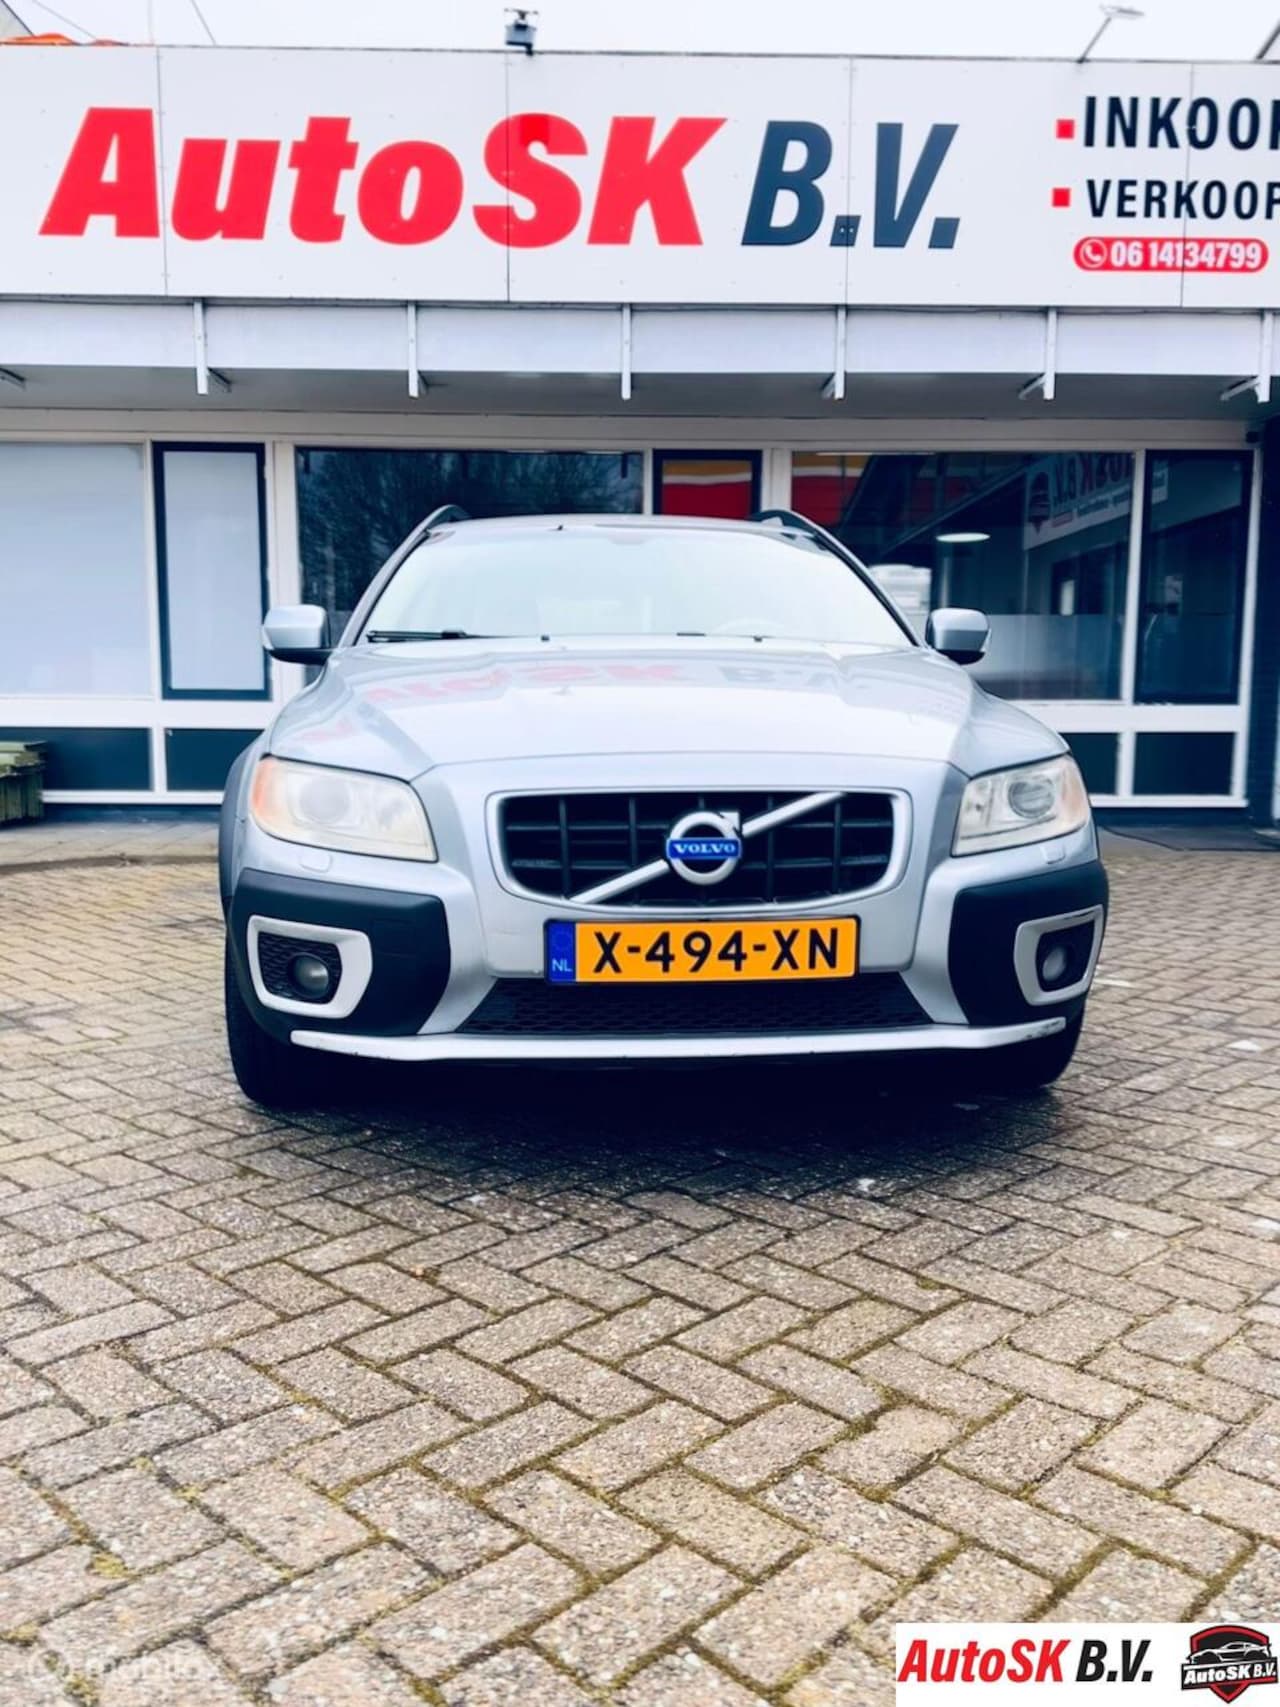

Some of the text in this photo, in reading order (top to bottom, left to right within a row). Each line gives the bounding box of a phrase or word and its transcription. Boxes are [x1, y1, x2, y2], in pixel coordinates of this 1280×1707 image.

[40, 107, 961, 249] AutoSK B.V.
[1111, 241, 1262, 270] 06 14134799
[673, 843, 736, 854] VOLVO
[552, 958, 573, 973] NL
[593, 928, 839, 974] X-494-XN
